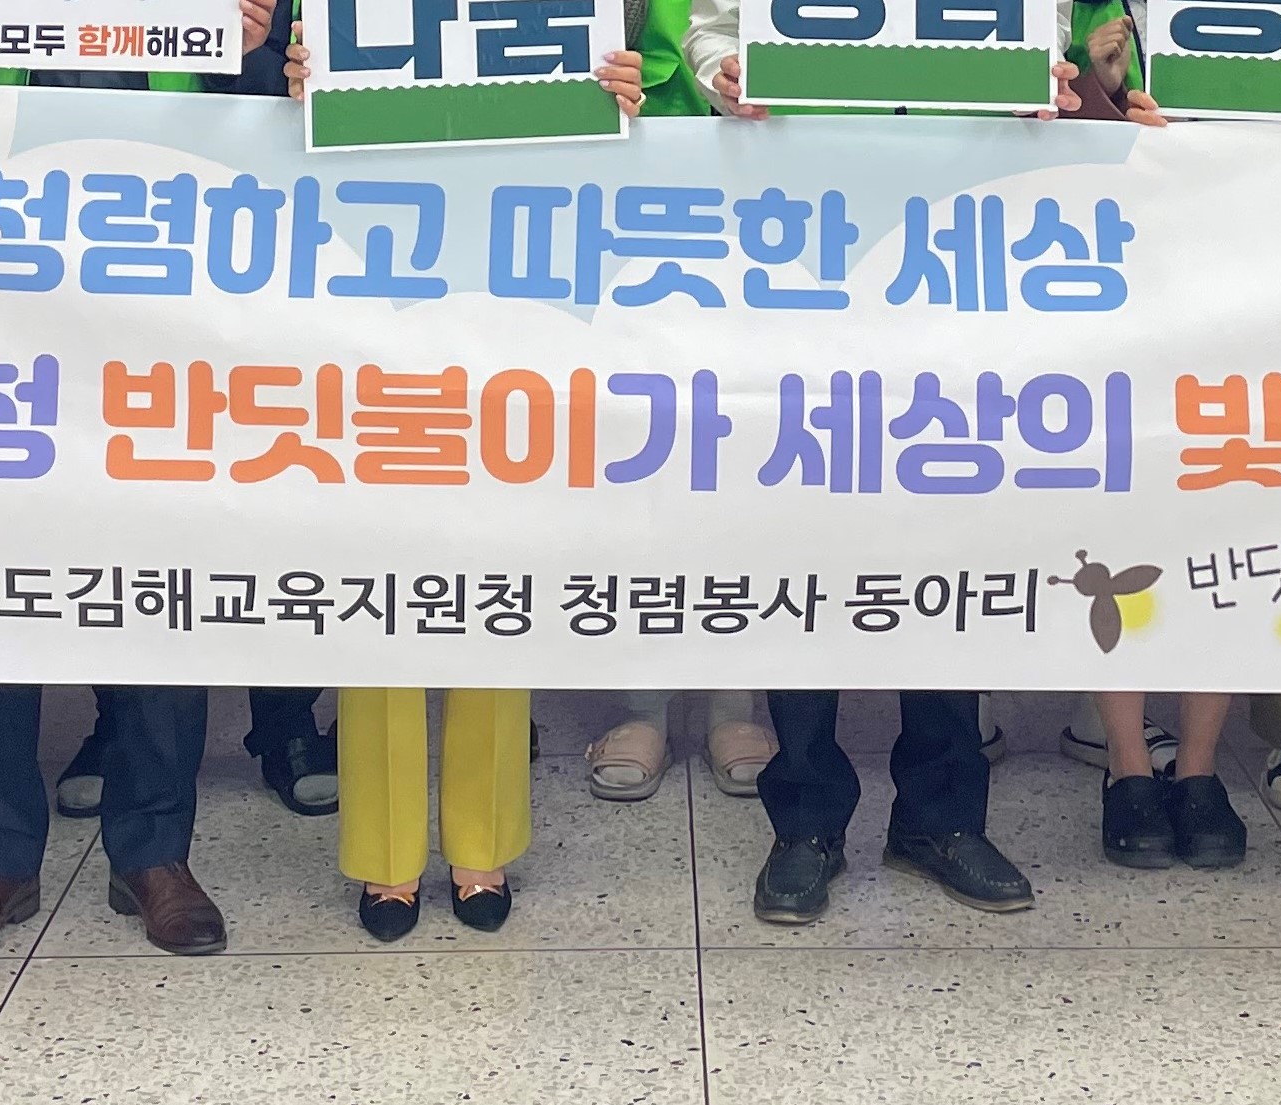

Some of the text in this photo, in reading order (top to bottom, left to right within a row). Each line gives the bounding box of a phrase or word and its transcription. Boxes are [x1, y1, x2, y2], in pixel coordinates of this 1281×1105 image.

[79, 25, 224, 58] 함께해요!
[488, 184, 859, 310] 따뜻한
[886, 195, 1135, 312] 세상
[101, 358, 731, 491] 반딧불이가
[759, 370, 1132, 494] 세상의
[559, 574, 828, 636] 청렴봉사
[844, 568, 1038, 633] 동아리
